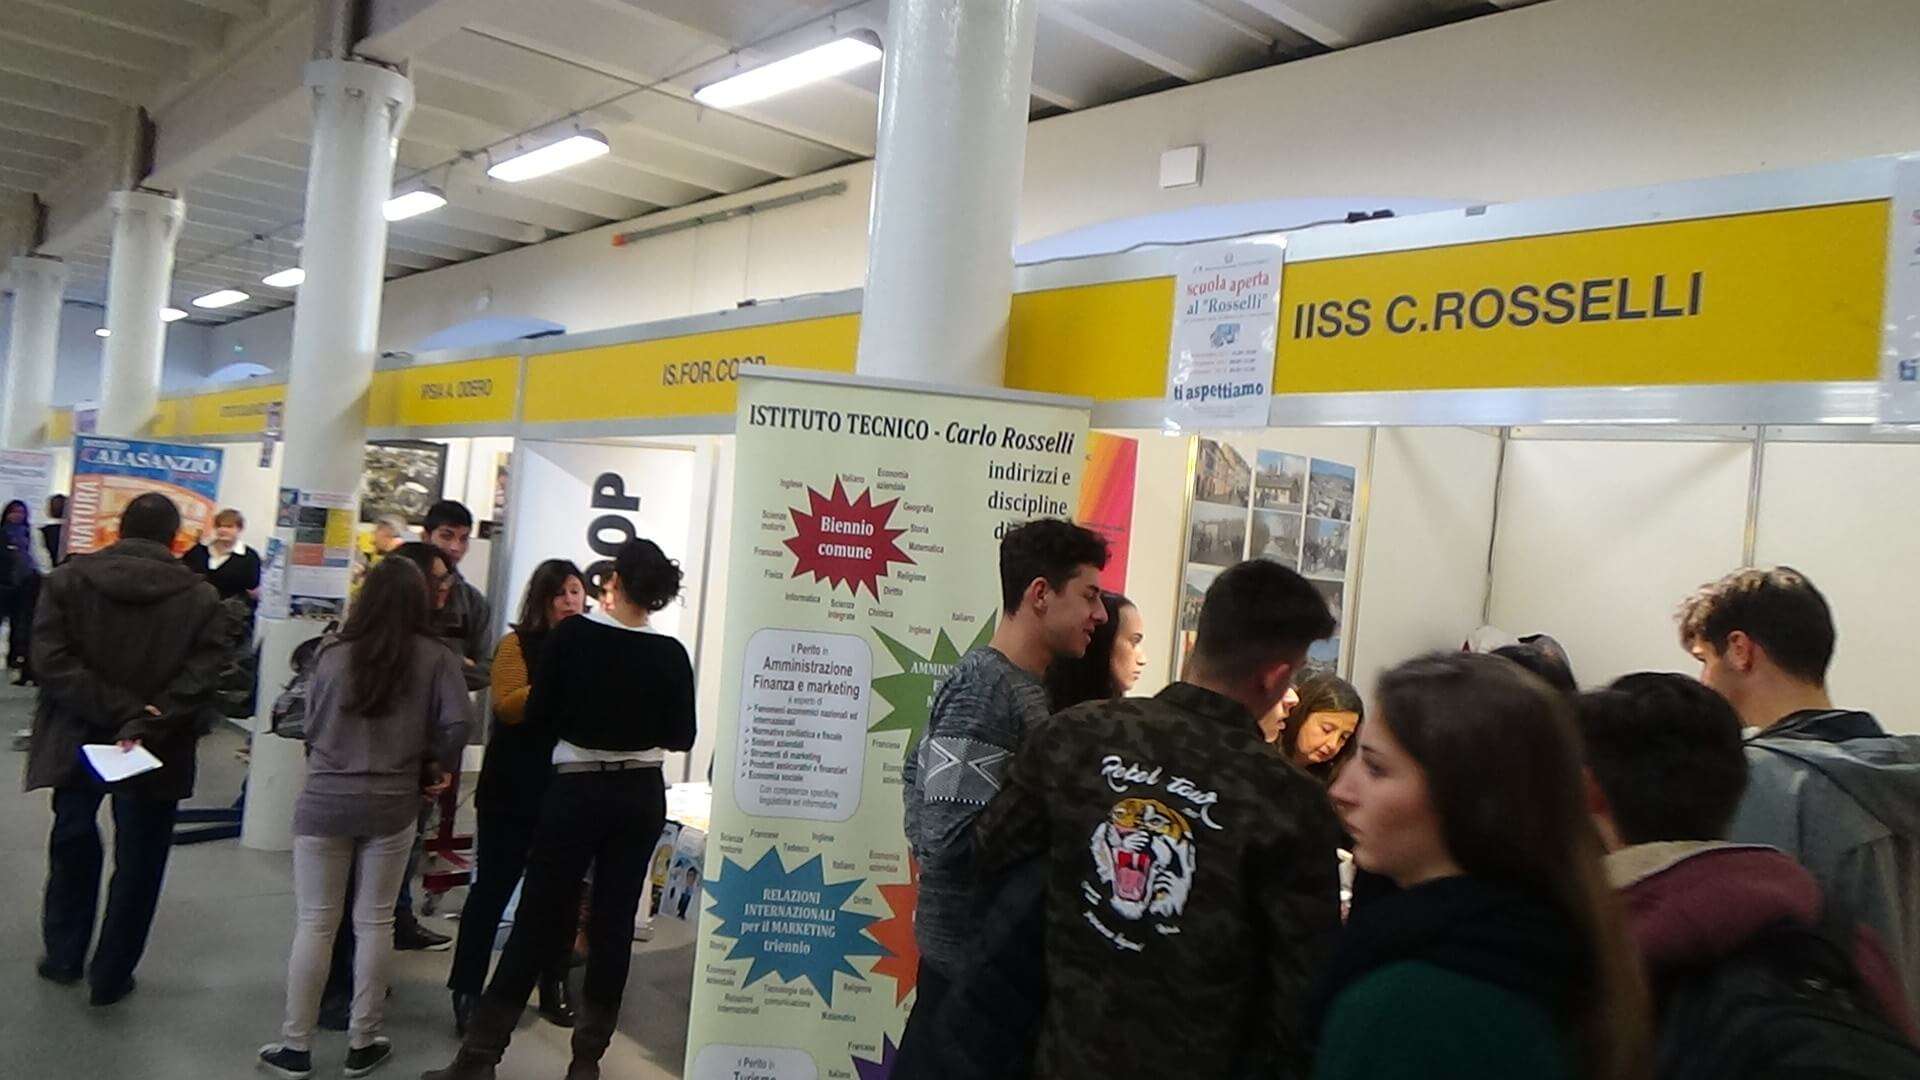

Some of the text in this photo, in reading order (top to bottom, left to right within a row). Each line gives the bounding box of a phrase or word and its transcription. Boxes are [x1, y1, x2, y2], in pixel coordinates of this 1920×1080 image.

[1229, 271, 1269, 296] aperta
[1187, 299, 1199, 314] al
[1293, 271, 1704, 340] IISS C.ROSSELLI
[1174, 382, 1264, 402] ti aspettiamo
[749, 404, 842, 432] ISTITUTO
[847, 413, 929, 440] TECNICO
[945, 422, 997, 447] Carlo
[1001, 427, 1075, 454] Rosselli
[82, 447, 216, 474] CALASANZIO
[877, 468, 909, 479] Economia
[988, 460, 1071, 486] indirizzi e
[903, 502, 934, 514] Geografia
[988, 490, 1068, 517] discipline
[69, 481, 101, 548] NATURA
[820, 516, 875, 537] Biennio
[818, 543, 873, 559] comune
[908, 542, 944, 554] Matematica
[868, 608, 894, 618] Chimica
[797, 643, 820, 655] Perito
[763, 657, 853, 677] Amministrazione
[753, 675, 860, 700] Finanza e marketing
[763, 888, 821, 905] RELAZIONI
[744, 903, 836, 922] INTERNAZIONALI
[741, 920, 836, 938] per il MARKETING
[763, 939, 811, 955] triennio
[743, 1057, 767, 1070] Perito
